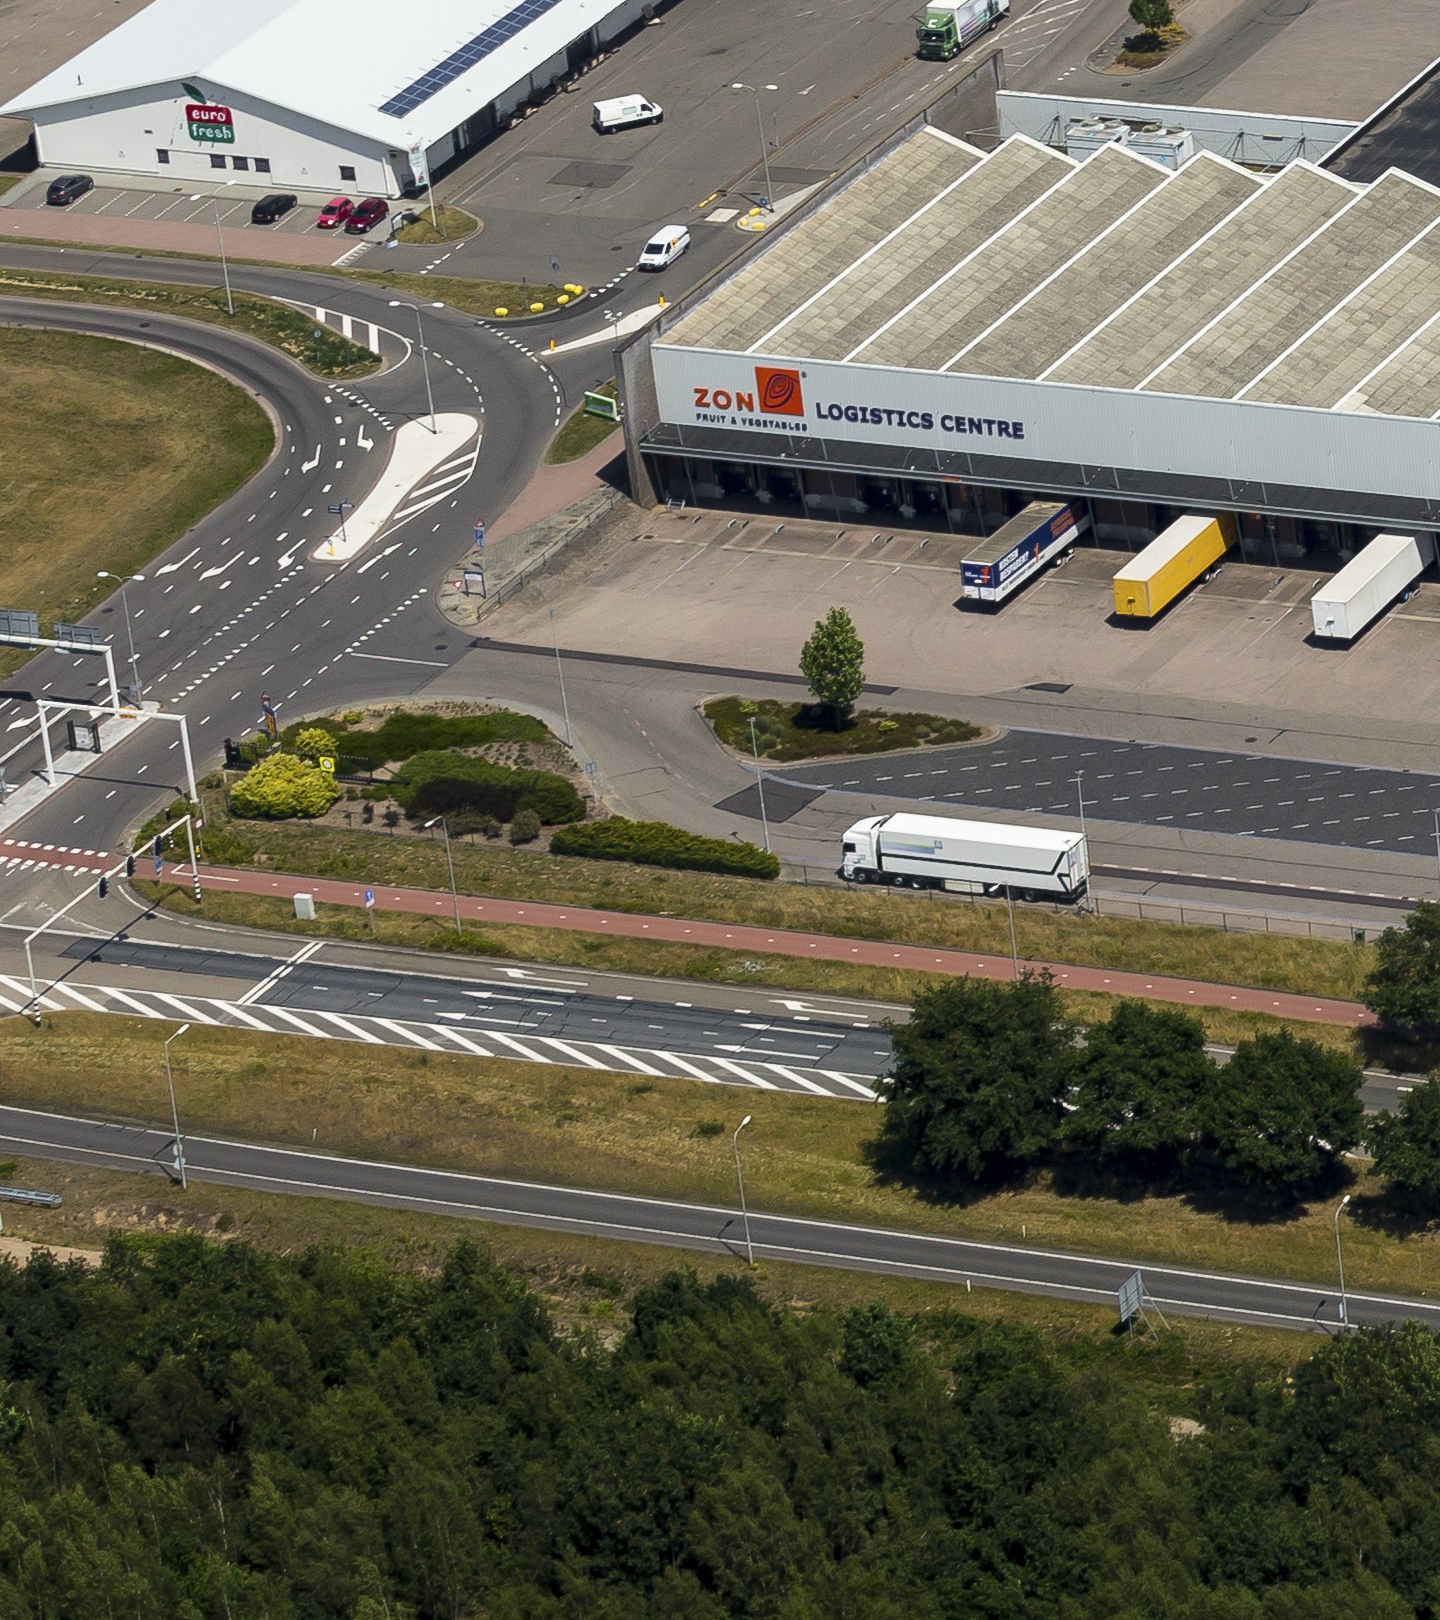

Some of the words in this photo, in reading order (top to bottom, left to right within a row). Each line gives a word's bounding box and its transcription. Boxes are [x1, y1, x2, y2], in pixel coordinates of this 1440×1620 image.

[191, 109, 226, 122] euro
[191, 124, 232, 140] fresh
[693, 388, 755, 414] ZON
[695, 413, 726, 424] FRUIT
[730, 416, 738, 425] &
[741, 417, 808, 432] VEGETABLES
[815, 401, 935, 430] LOGISTICS
[941, 414, 1026, 440] CENTRE
